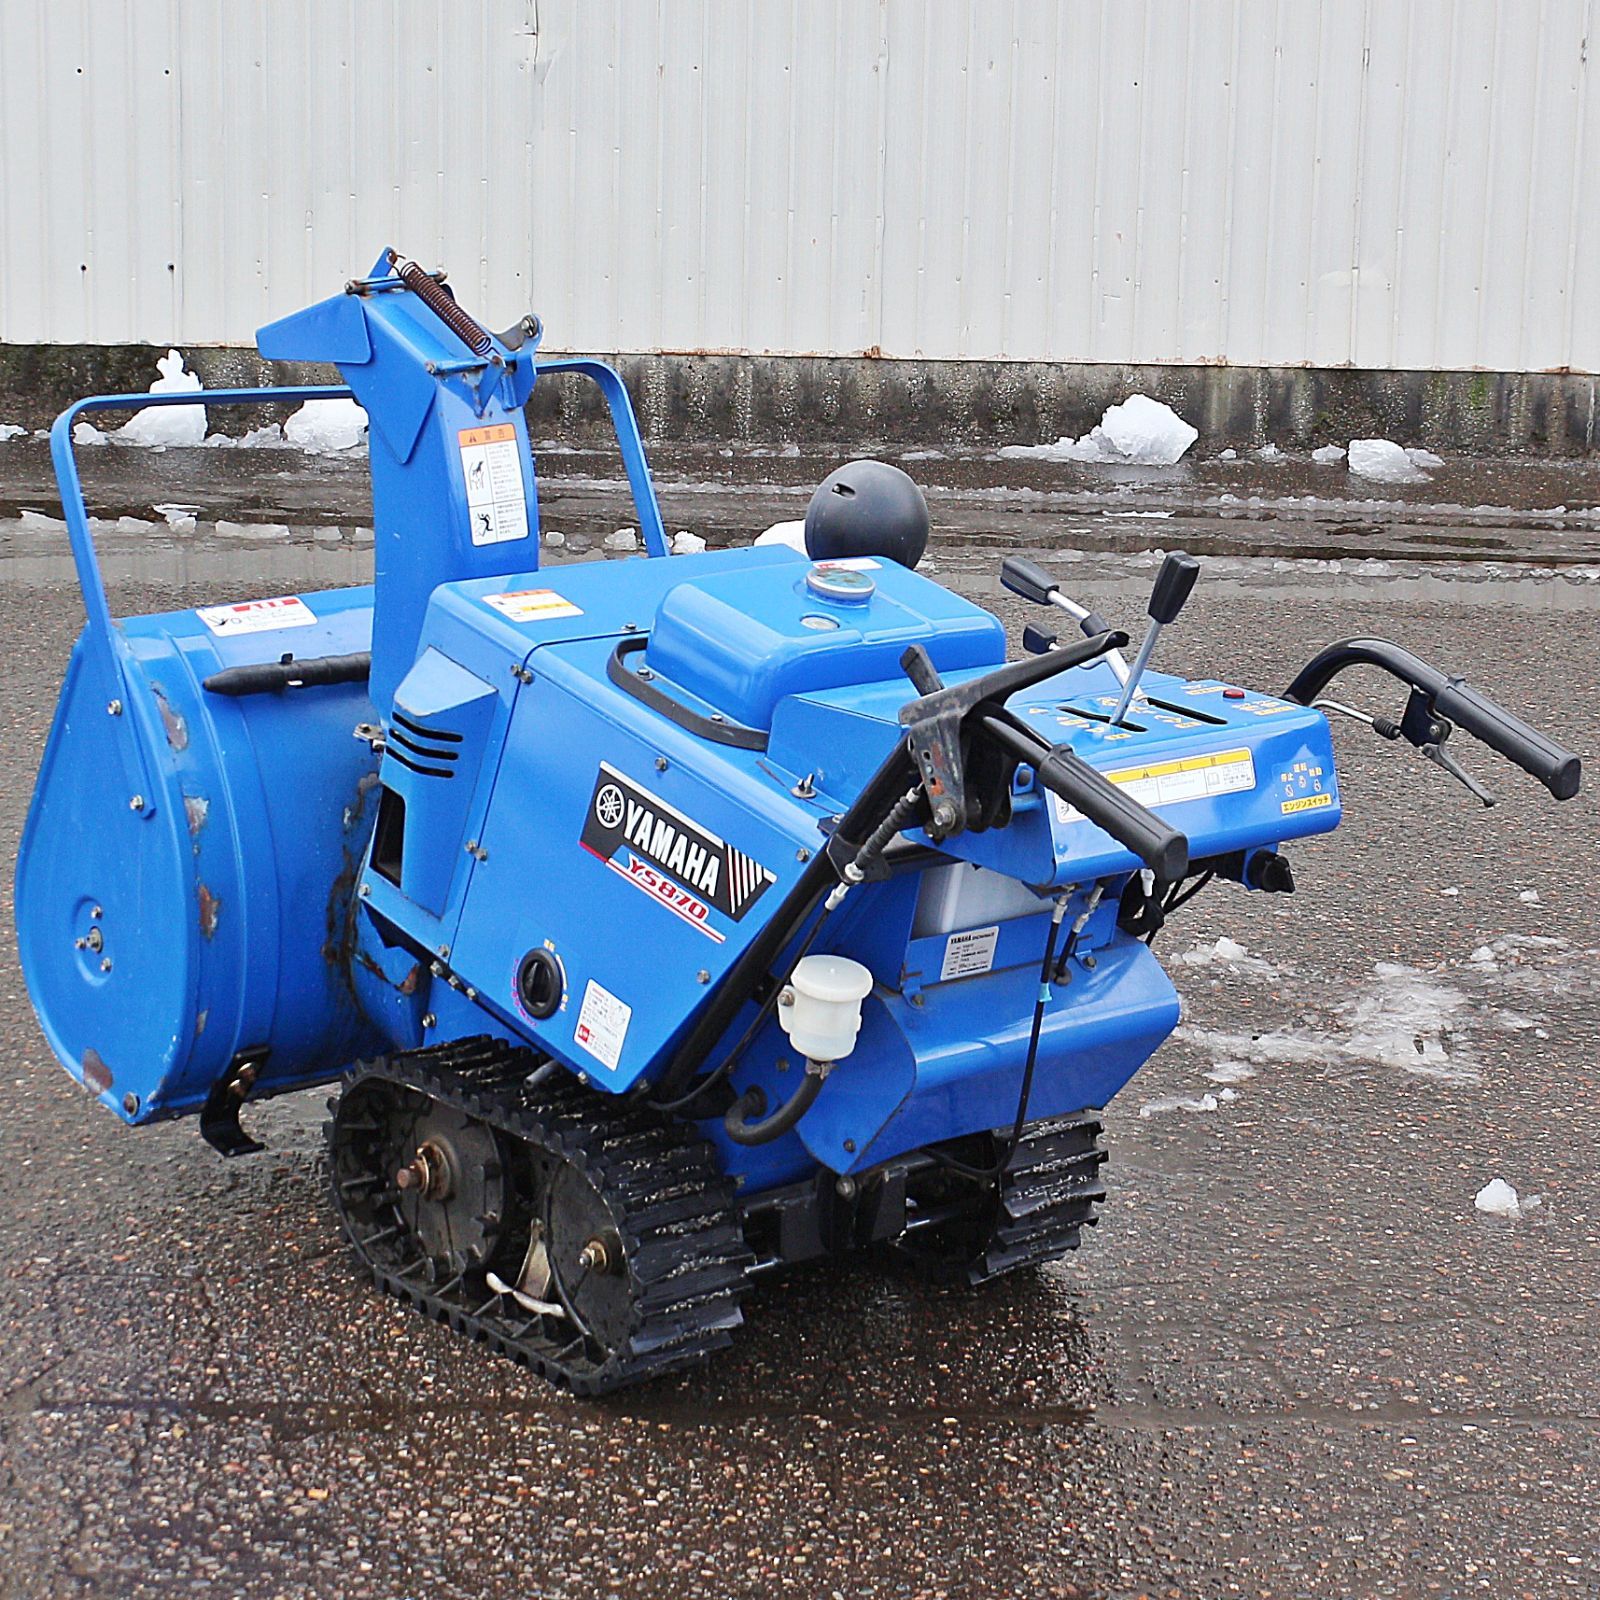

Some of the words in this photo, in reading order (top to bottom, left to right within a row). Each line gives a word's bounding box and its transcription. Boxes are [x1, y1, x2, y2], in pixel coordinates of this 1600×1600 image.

[1283, 795, 1329, 812] エンジンスイッチ
[624, 798, 720, 897] YAMAHA
[627, 855, 709, 920] YS870
